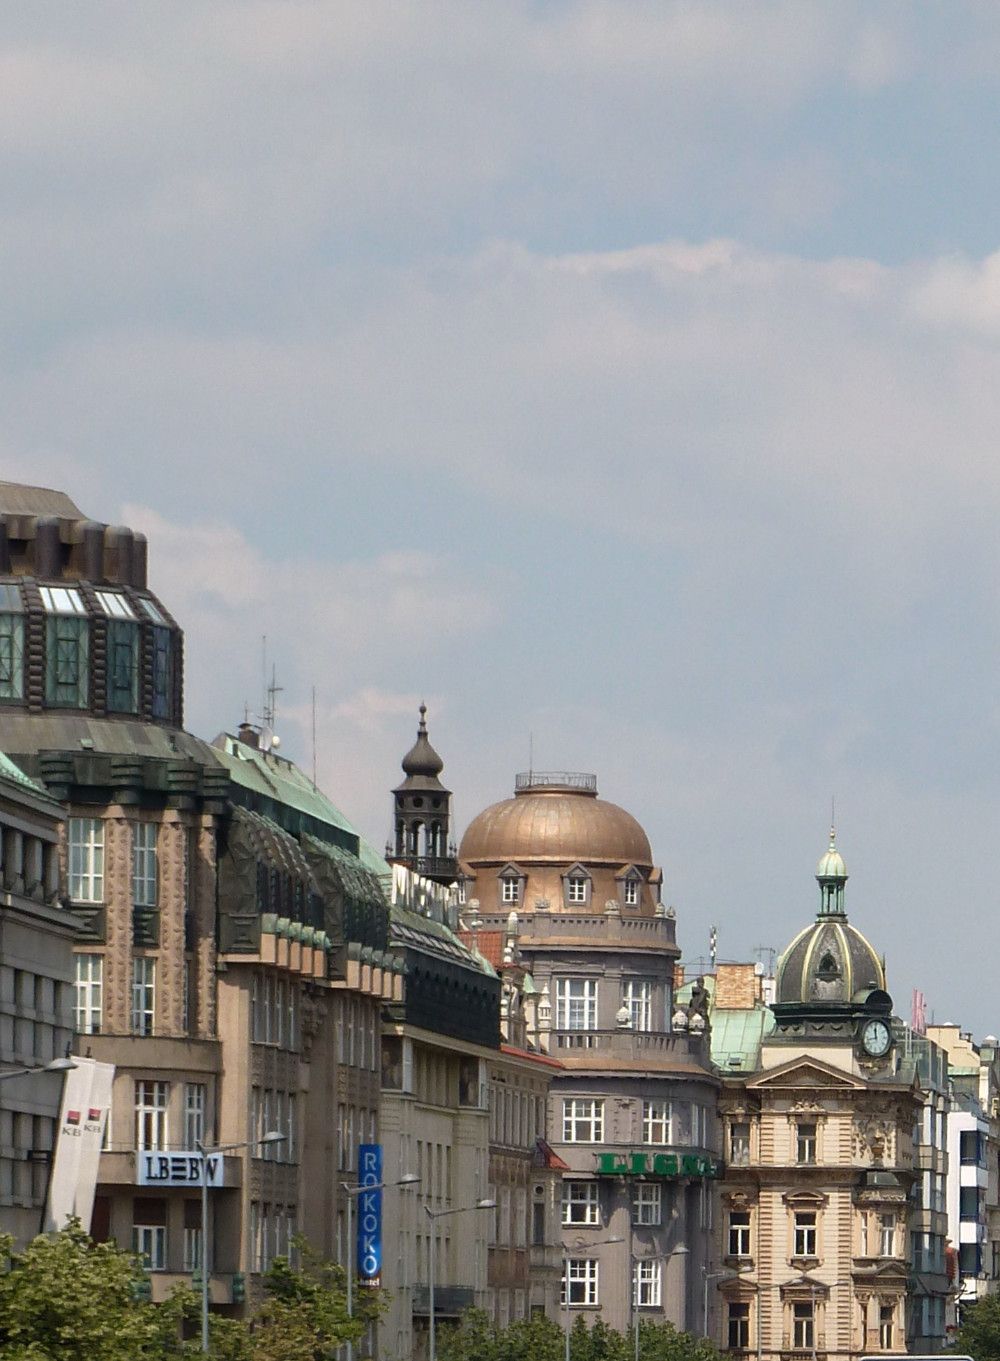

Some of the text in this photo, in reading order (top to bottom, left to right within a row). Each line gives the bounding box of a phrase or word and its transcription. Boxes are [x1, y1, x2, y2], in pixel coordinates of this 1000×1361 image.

[62, 1126, 82, 1137] KB
[83, 1124, 102, 1134] KB
[363, 1152, 378, 1274] ROKOKO
